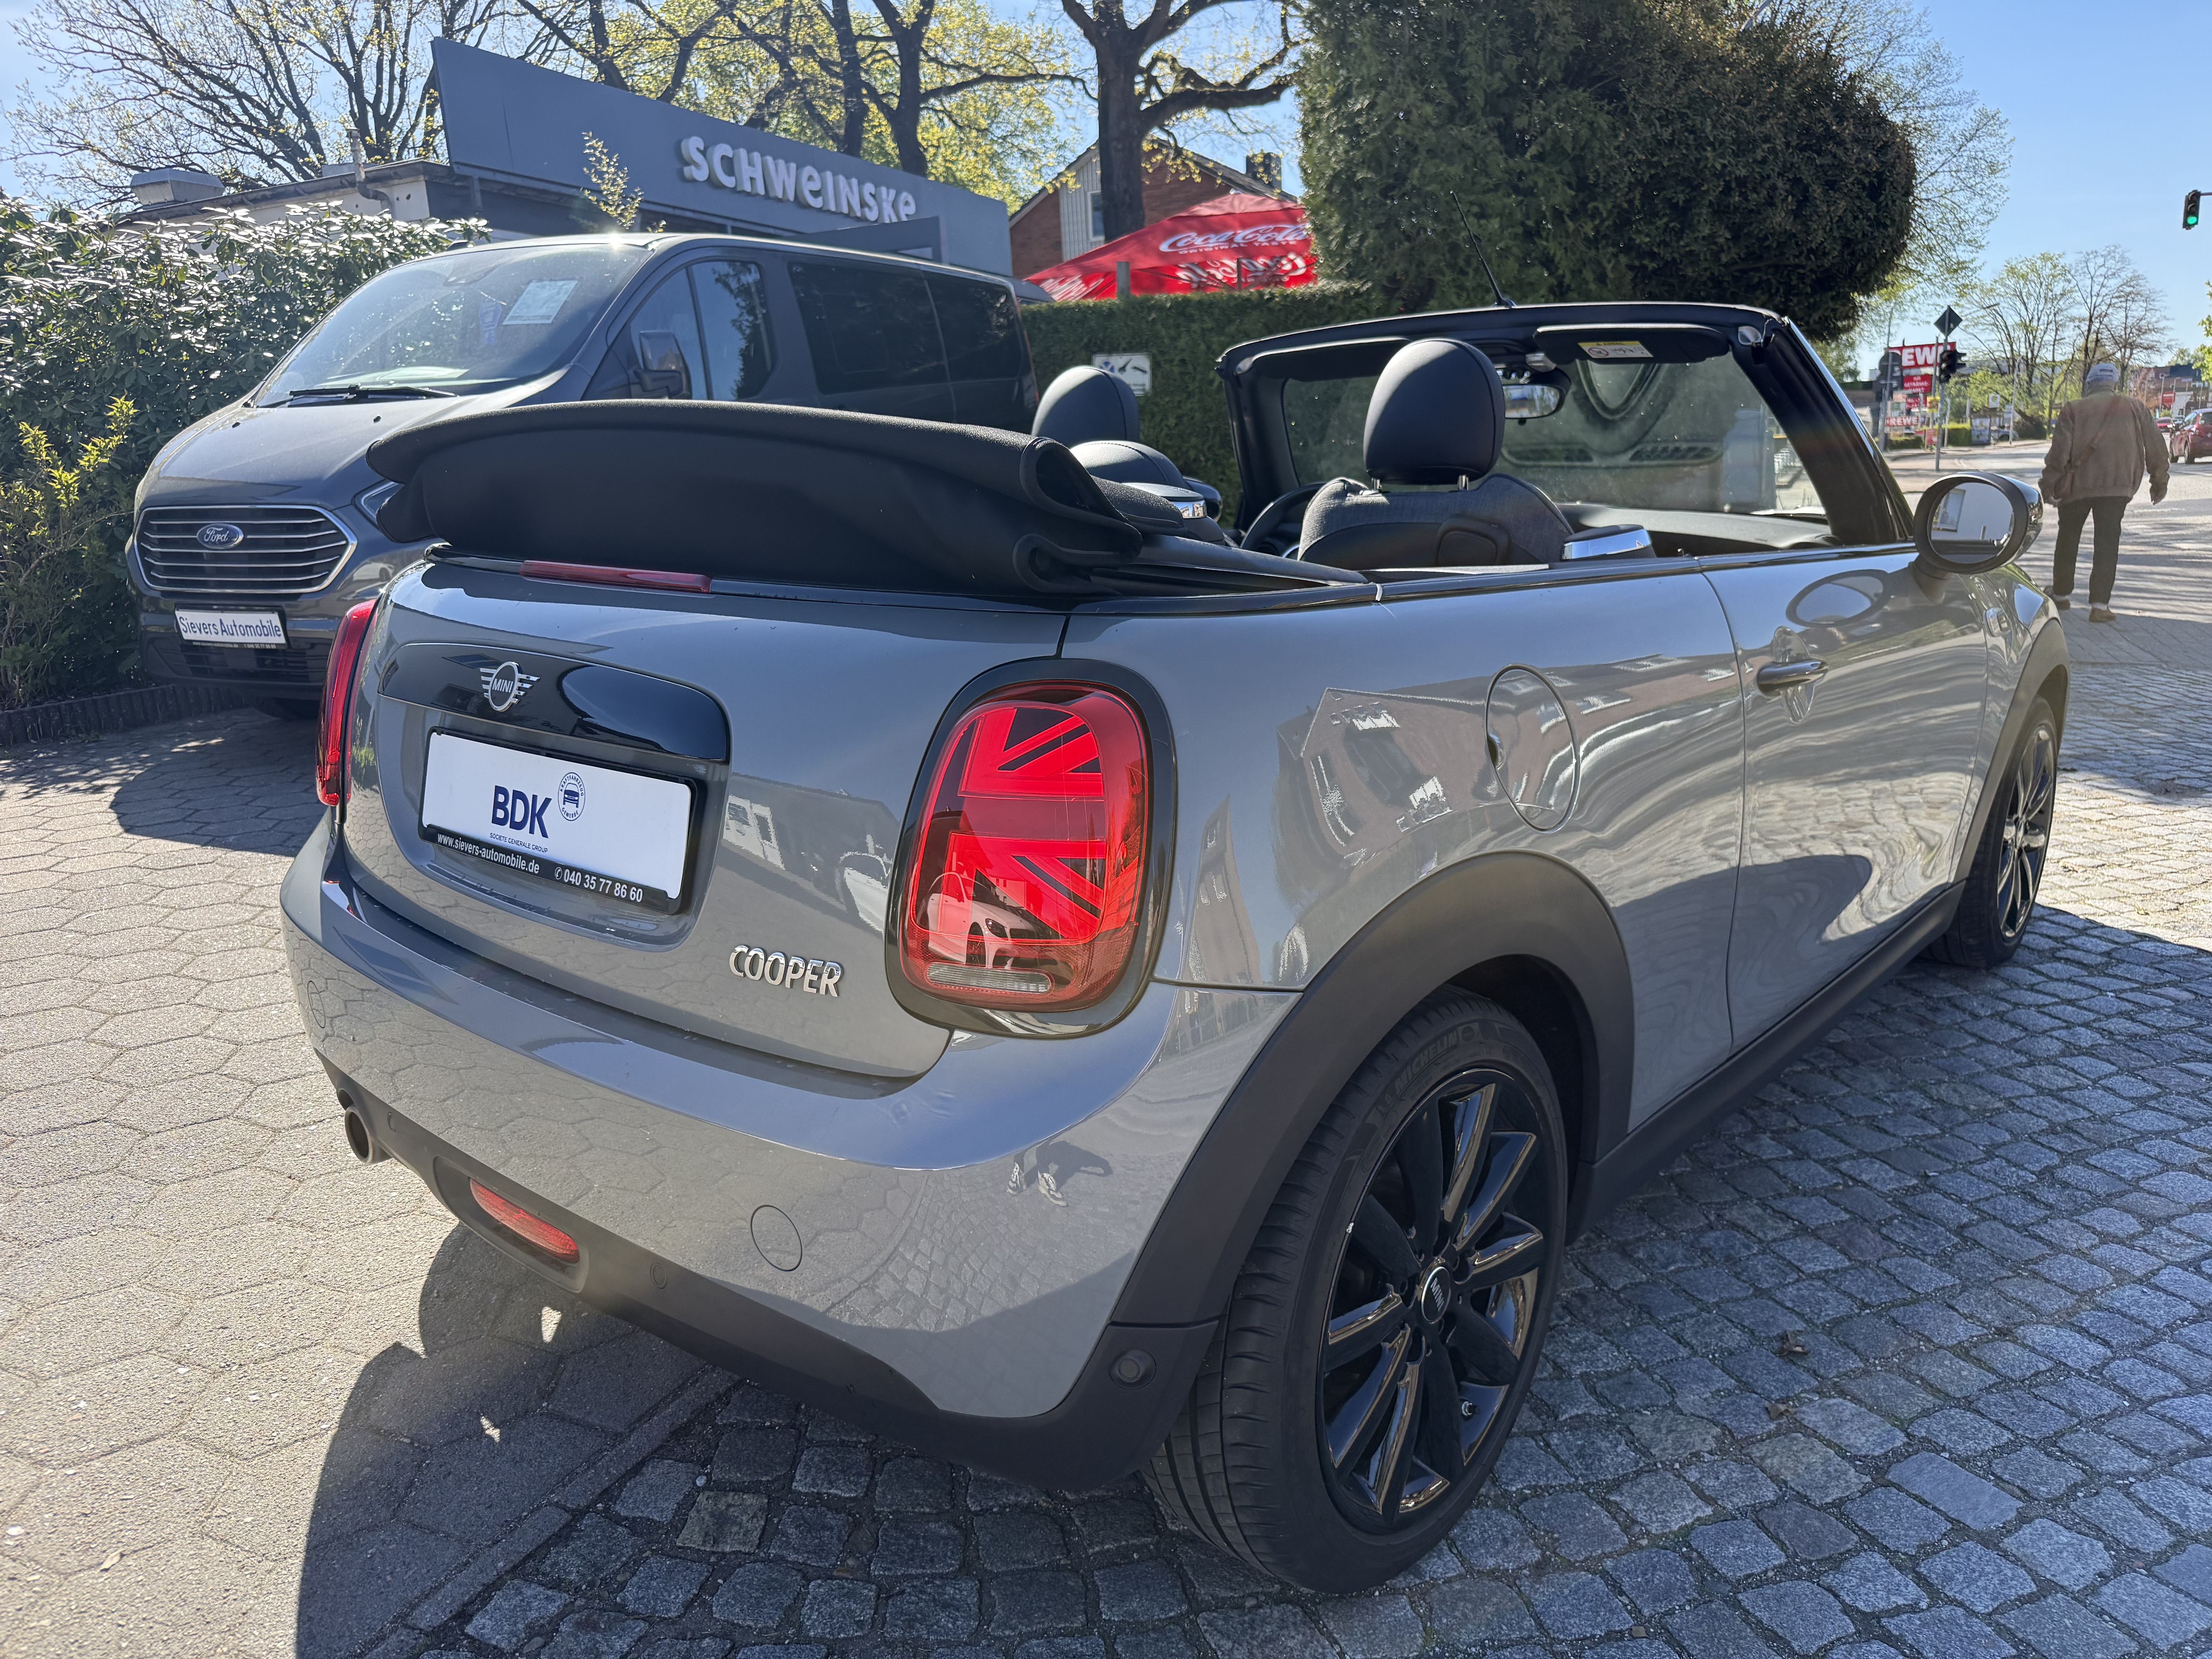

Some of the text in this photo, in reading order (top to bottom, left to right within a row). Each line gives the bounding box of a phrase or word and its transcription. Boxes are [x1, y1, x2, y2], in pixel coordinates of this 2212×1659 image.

[1178, 242, 1247, 254] ORIGINAL
[1888, 345, 1951, 367] EW
[204, 527, 229, 542] Ford
[179, 616, 282, 637] Sievers Automobile
[492, 678, 514, 693] MINI
[560, 775, 584, 797] KRAFTFAHRZEUG
[491, 785, 552, 839] BDK
[562, 807, 579, 819] GEWERBE
[532, 844, 548, 853] GROUP
[438, 833, 643, 902] www.sievers-automobile.de 040 35 77 86 60
[729, 945, 842, 997] COOPER
[1394, 1030, 1458, 1096] MICHELIN
[1430, 1276, 1444, 1312] MINI
